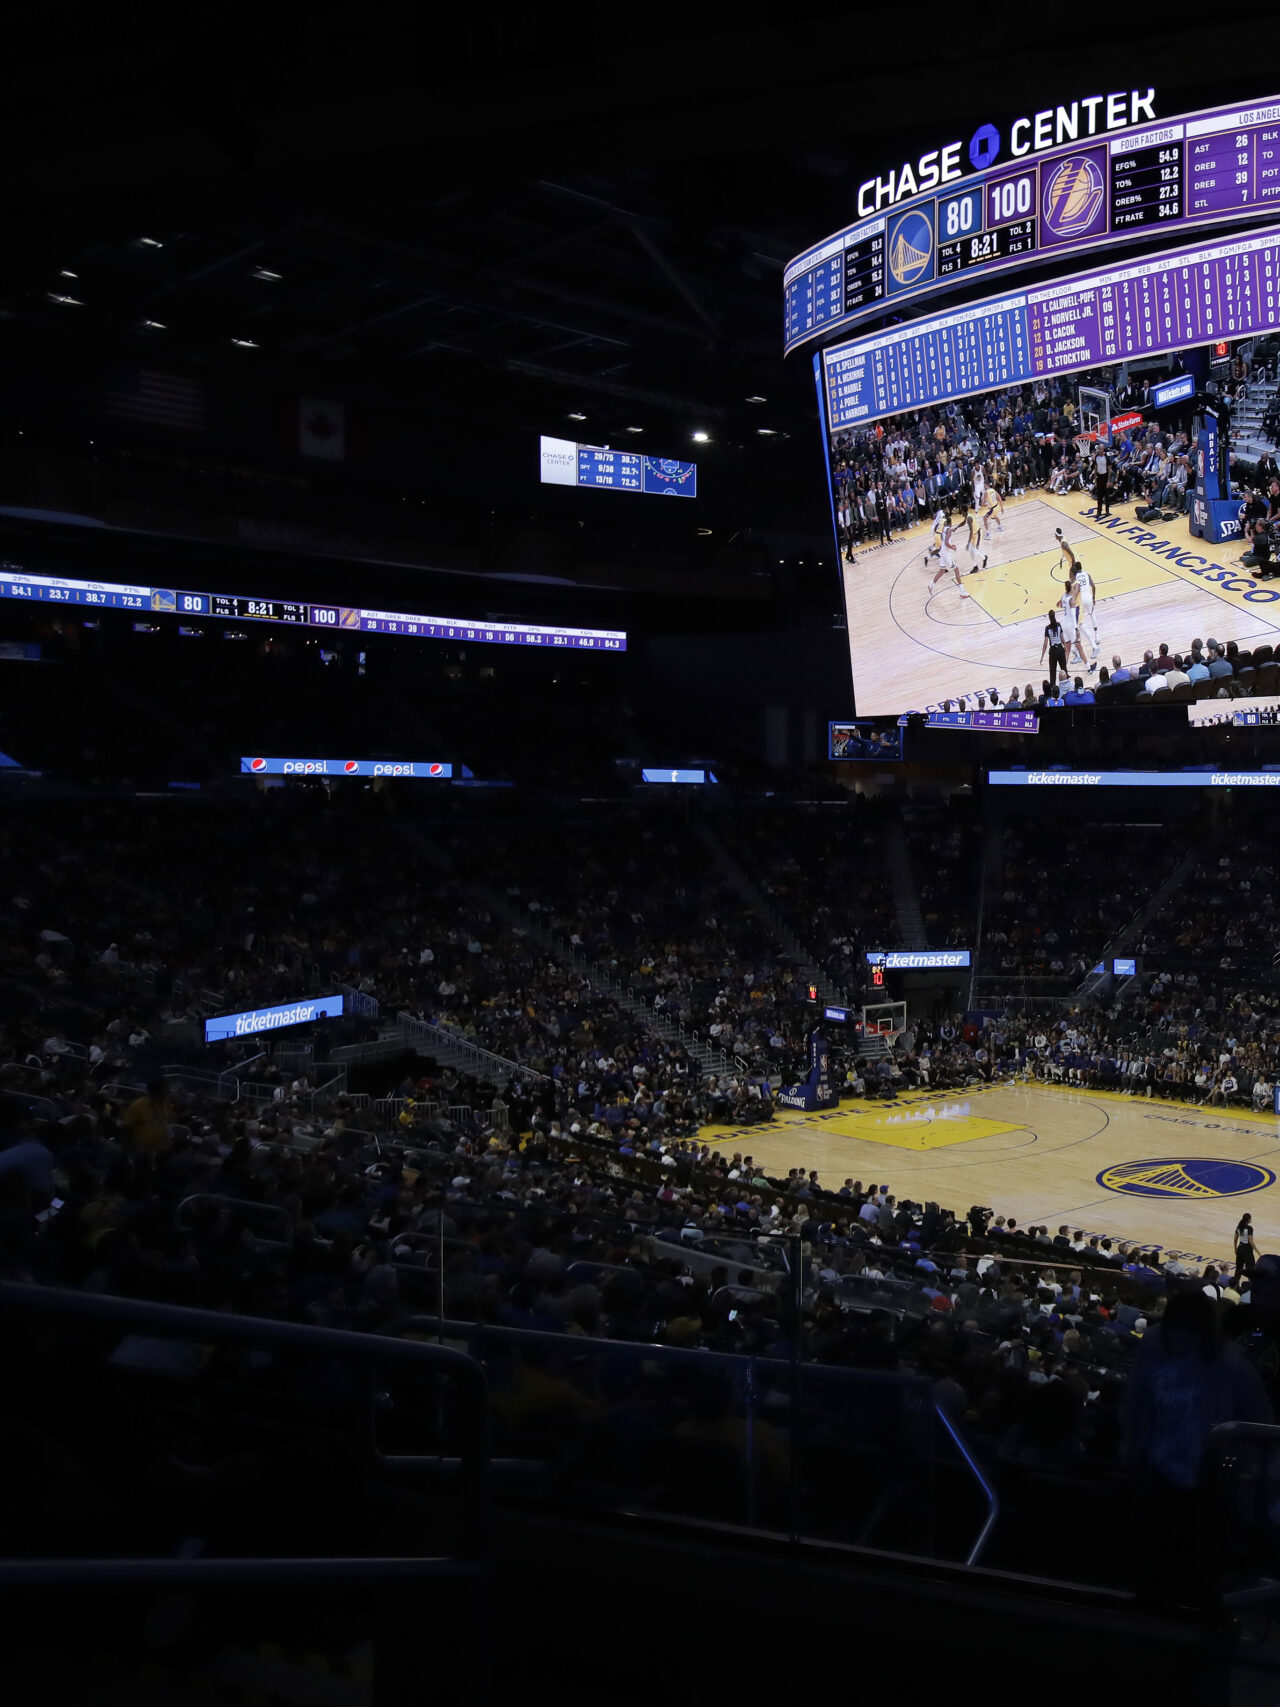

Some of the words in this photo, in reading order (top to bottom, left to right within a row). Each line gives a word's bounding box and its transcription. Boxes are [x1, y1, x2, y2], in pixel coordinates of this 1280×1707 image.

[1239, 112, 1254, 125] LOS
[1120, 136, 1140, 150] FOUR
[1141, 129, 1173, 145] FACTORS
[1262, 131, 1278, 141] BLK
[1194, 144, 1210, 154] AST
[1235, 134, 1248, 147] 26
[858, 141, 962, 217] CHASE
[1011, 88, 1156, 156] CENTER
[1115, 160, 1136, 171] EFG%
[1159, 148, 1178, 163] 54.9
[1262, 151, 1273, 160] TO
[1194, 161, 1216, 172] OREB
[1237, 153, 1248, 165] 12
[1116, 179, 1132, 189] TO%
[1160, 166, 1178, 180] 12.2
[1194, 180, 1216, 190] DREB
[1235, 171, 1248, 184] 39
[1262, 168, 1279, 178] POT
[992, 178, 1030, 220] 100
[1115, 195, 1142, 206] OREB%
[1159, 184, 1178, 199] 27.3
[1194, 200, 1208, 208] STL
[1241, 189, 1248, 201] 7
[1262, 187, 1280, 197] PITP
[947, 197, 972, 235] 80
[1125, 212, 1144, 222] RATE
[1159, 202, 1178, 217] 34.6
[1009, 226, 1023, 236] TOL
[942, 247, 953, 256] TOL
[971, 232, 997, 258] 8:21
[1009, 242, 1022, 253] FLS
[1219, 242, 1252, 255] FGM/FGA
[1049, 290, 1095, 312] CALDWELL-POPE
[1051, 308, 1081, 326] NORVELL
[1052, 324, 1075, 339] CACOK
[1054, 336, 1085, 353] JACKSON
[1055, 349, 1090, 366] STOCKTON
[542, 452, 566, 460] CHASE
[1116, 526, 1280, 603] FRANCISCO
[12, 585, 32, 597] 54.1
[49, 589, 70, 600] 23.7
[86, 592, 106, 603] 38.7
[122, 595, 142, 607] 72.2
[184, 596, 202, 611] 80
[248, 601, 274, 616] 8:21
[314, 609, 336, 624] 100
[388, 622, 397, 632] 12
[408, 624, 417, 633] 39
[284, 760, 328, 774] pepsi
[374, 762, 415, 777] pepsi
[671, 770, 678, 782] t
[1027, 772, 1101, 785] ticketmaster
[877, 953, 963, 967] tcketmaster
[235, 1005, 314, 1034] ticketmaster
[1144, 1114, 1203, 1127] CHASE
